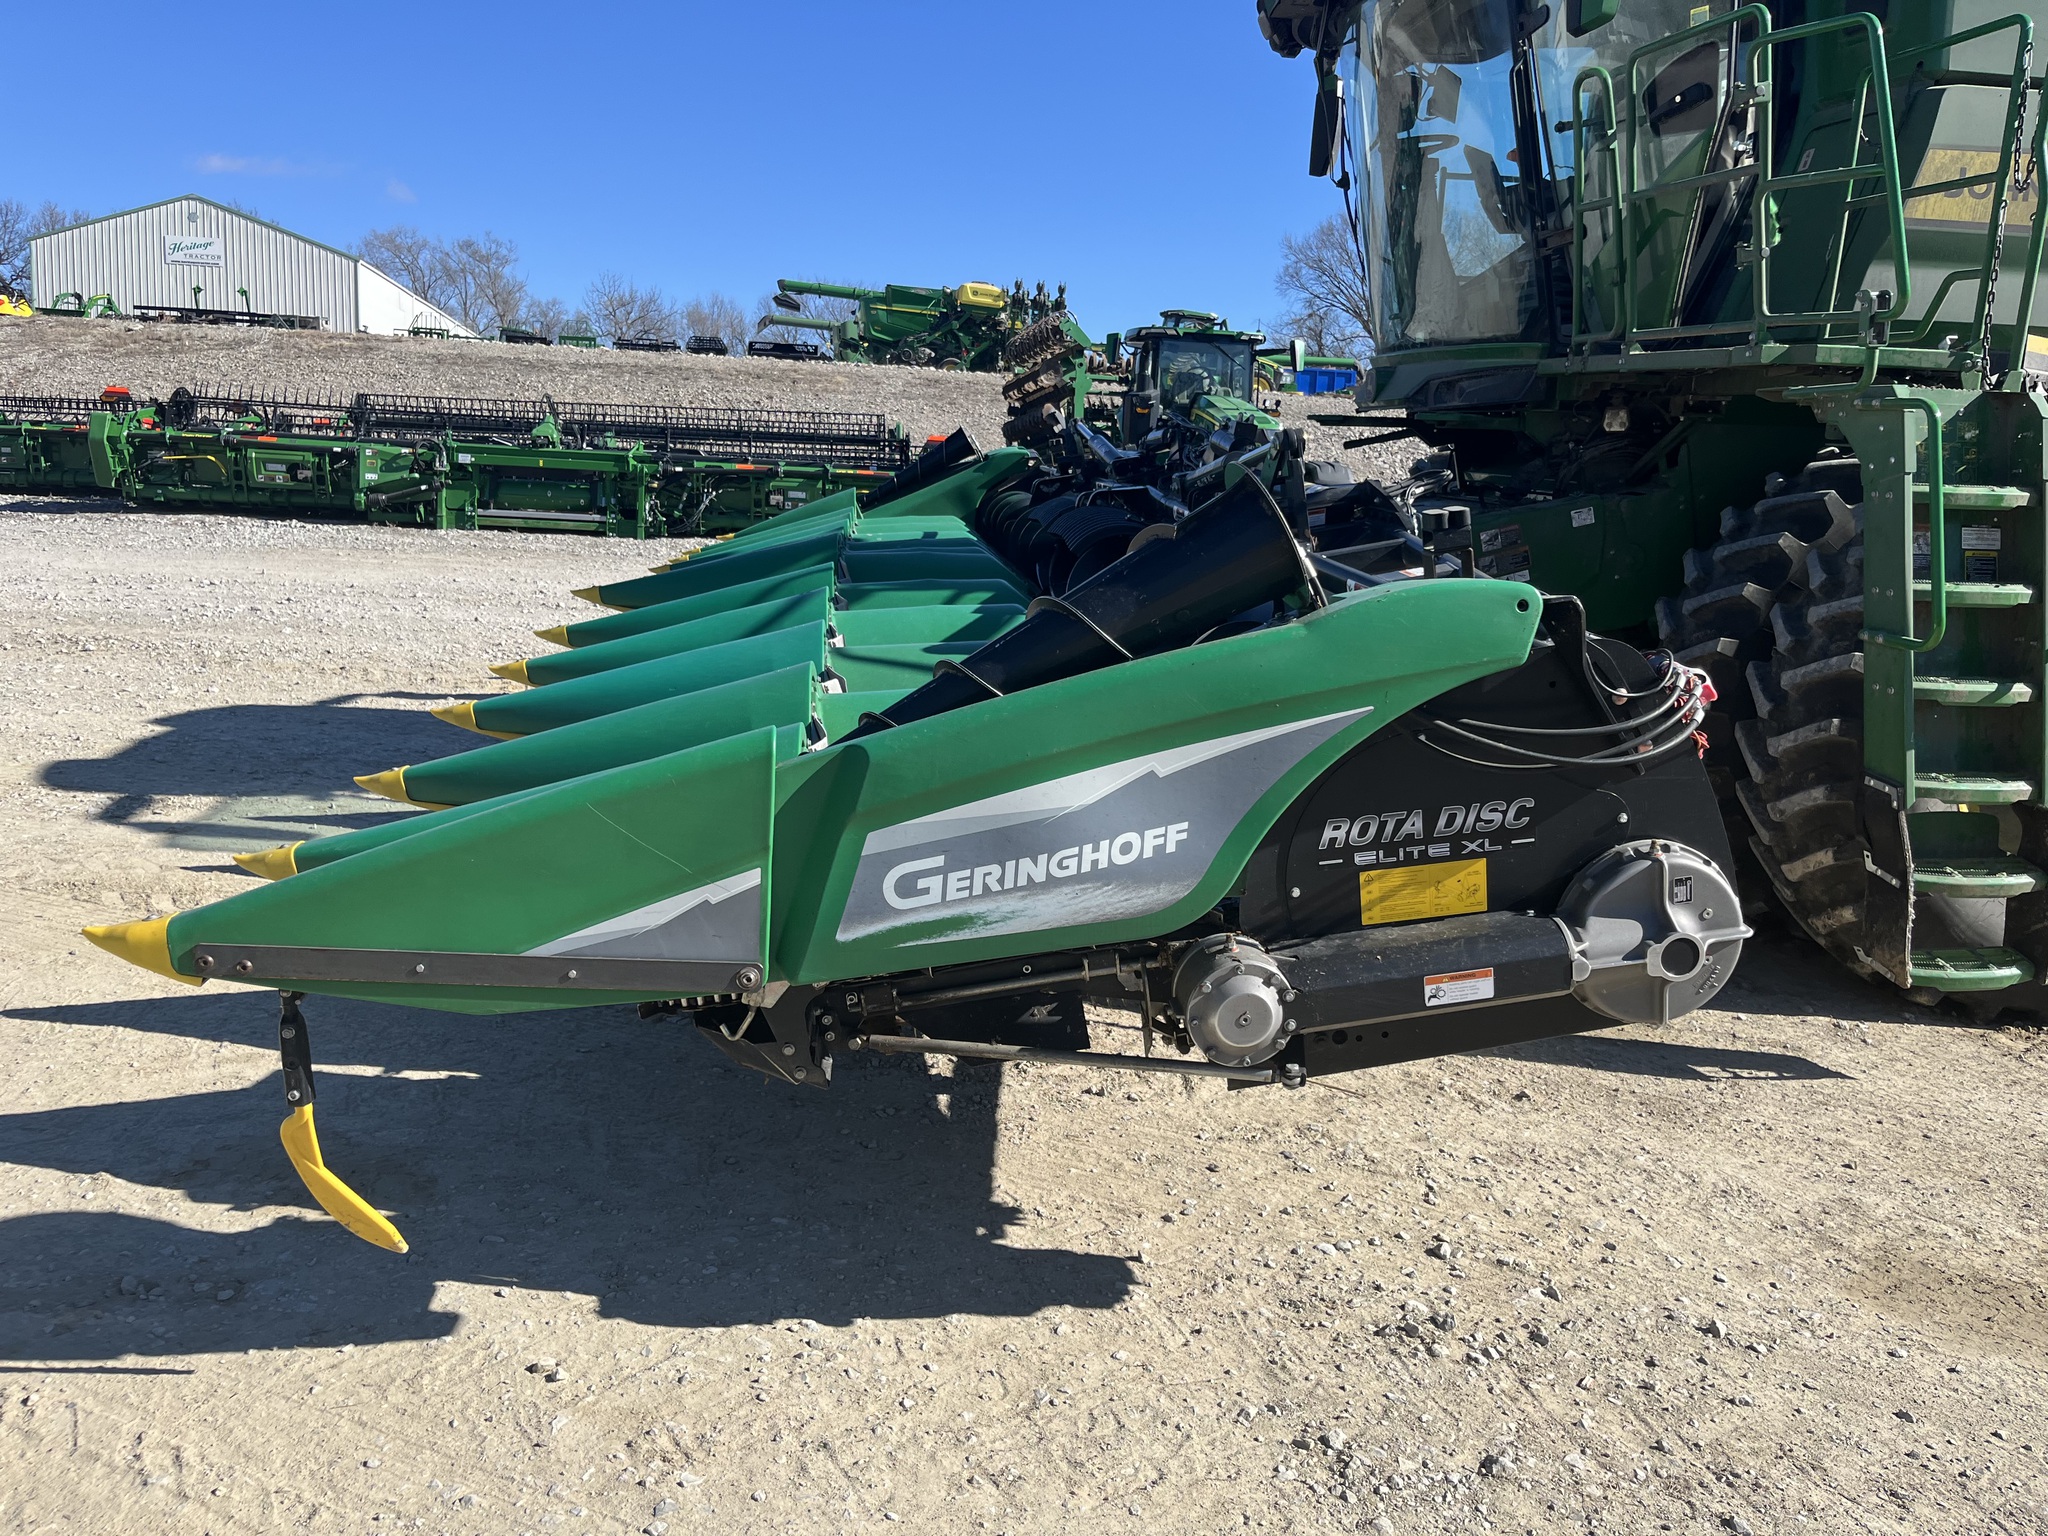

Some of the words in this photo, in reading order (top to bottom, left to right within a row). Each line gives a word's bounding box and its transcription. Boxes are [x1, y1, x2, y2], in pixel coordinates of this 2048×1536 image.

[168, 240, 215, 256] Heritage
[1318, 809, 1424, 850] ROTA
[1433, 797, 1535, 837] DISC
[883, 821, 1190, 909] GERINGHOFF
[1354, 842, 1451, 866] ELITE
[1461, 838, 1503, 855] XL
[1449, 972, 1477, 981] WARNING
